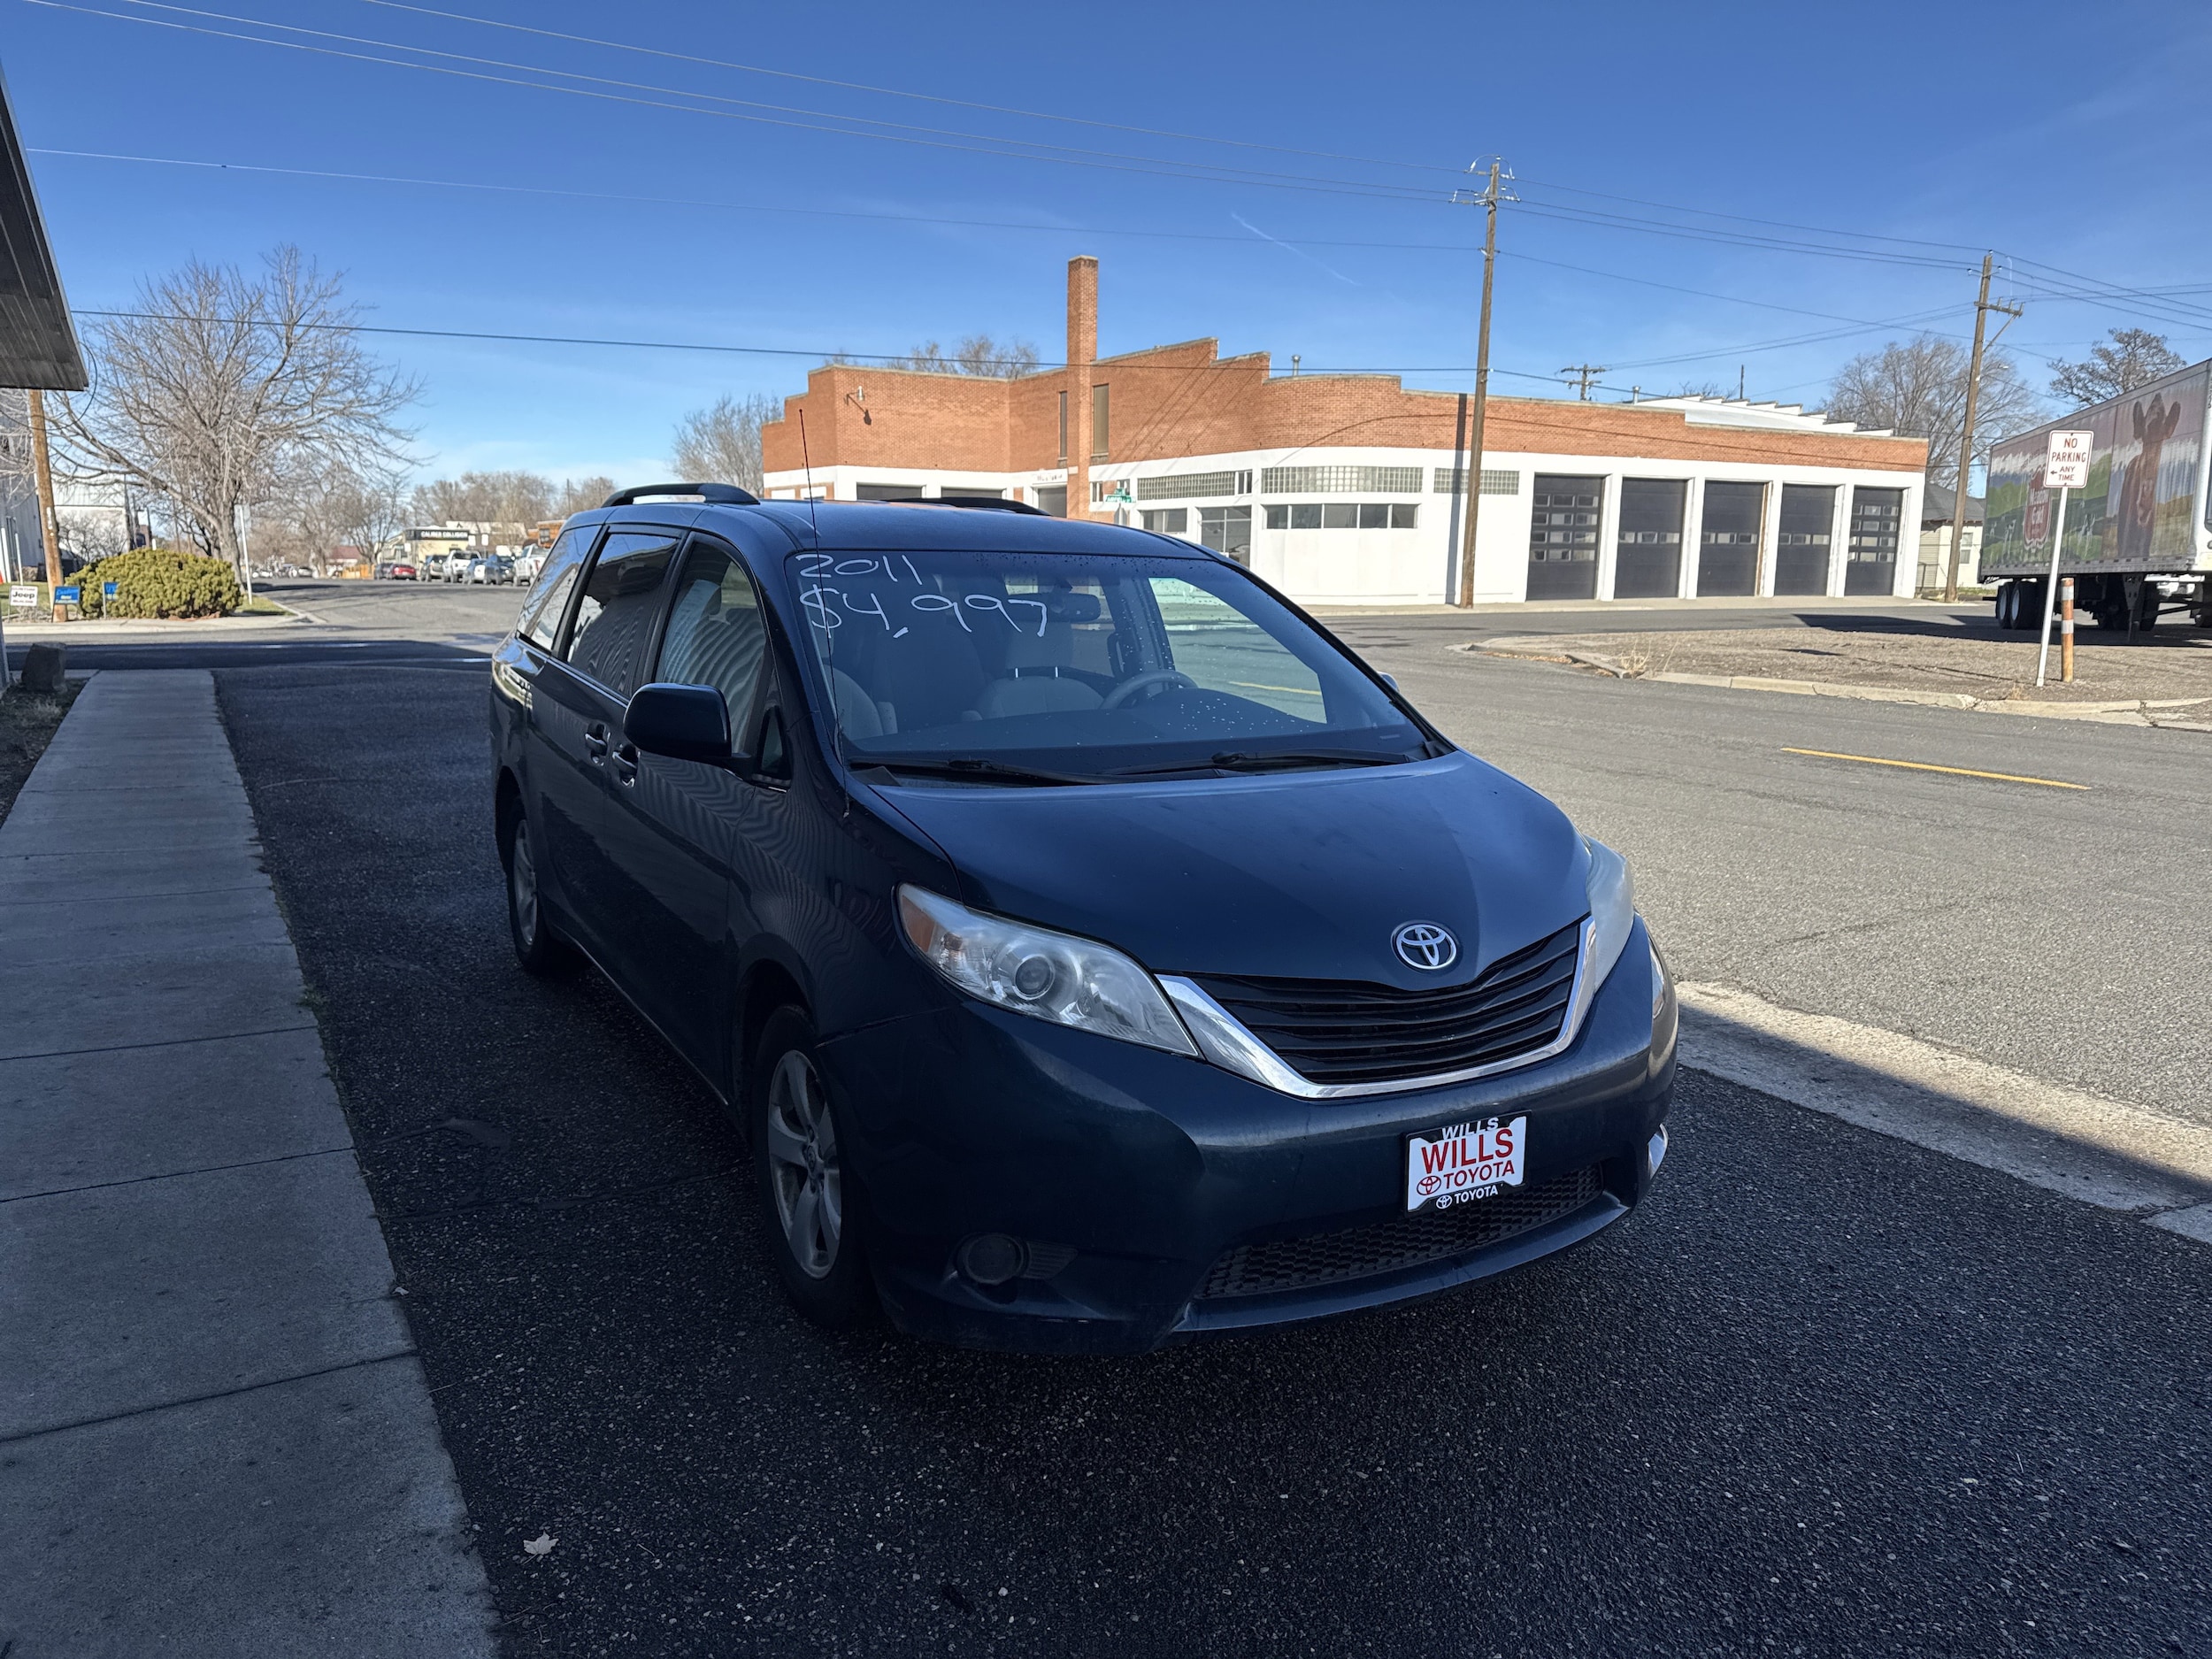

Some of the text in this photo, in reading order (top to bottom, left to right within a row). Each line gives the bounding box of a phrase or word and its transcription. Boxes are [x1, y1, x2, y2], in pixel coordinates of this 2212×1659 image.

[2063, 438, 2078, 448] NO
[2051, 451, 2086, 462] PARKING
[795, 554, 923, 586] 2011
[12, 591, 35, 600] Jeep
[799, 583, 1048, 639] $4,997
[1441, 1117, 1499, 1141] WILLS
[1421, 1128, 1514, 1174] WILLS
[1443, 1160, 1515, 1189] TOYOTA
[1454, 1184, 1499, 1204] TOYOTA
